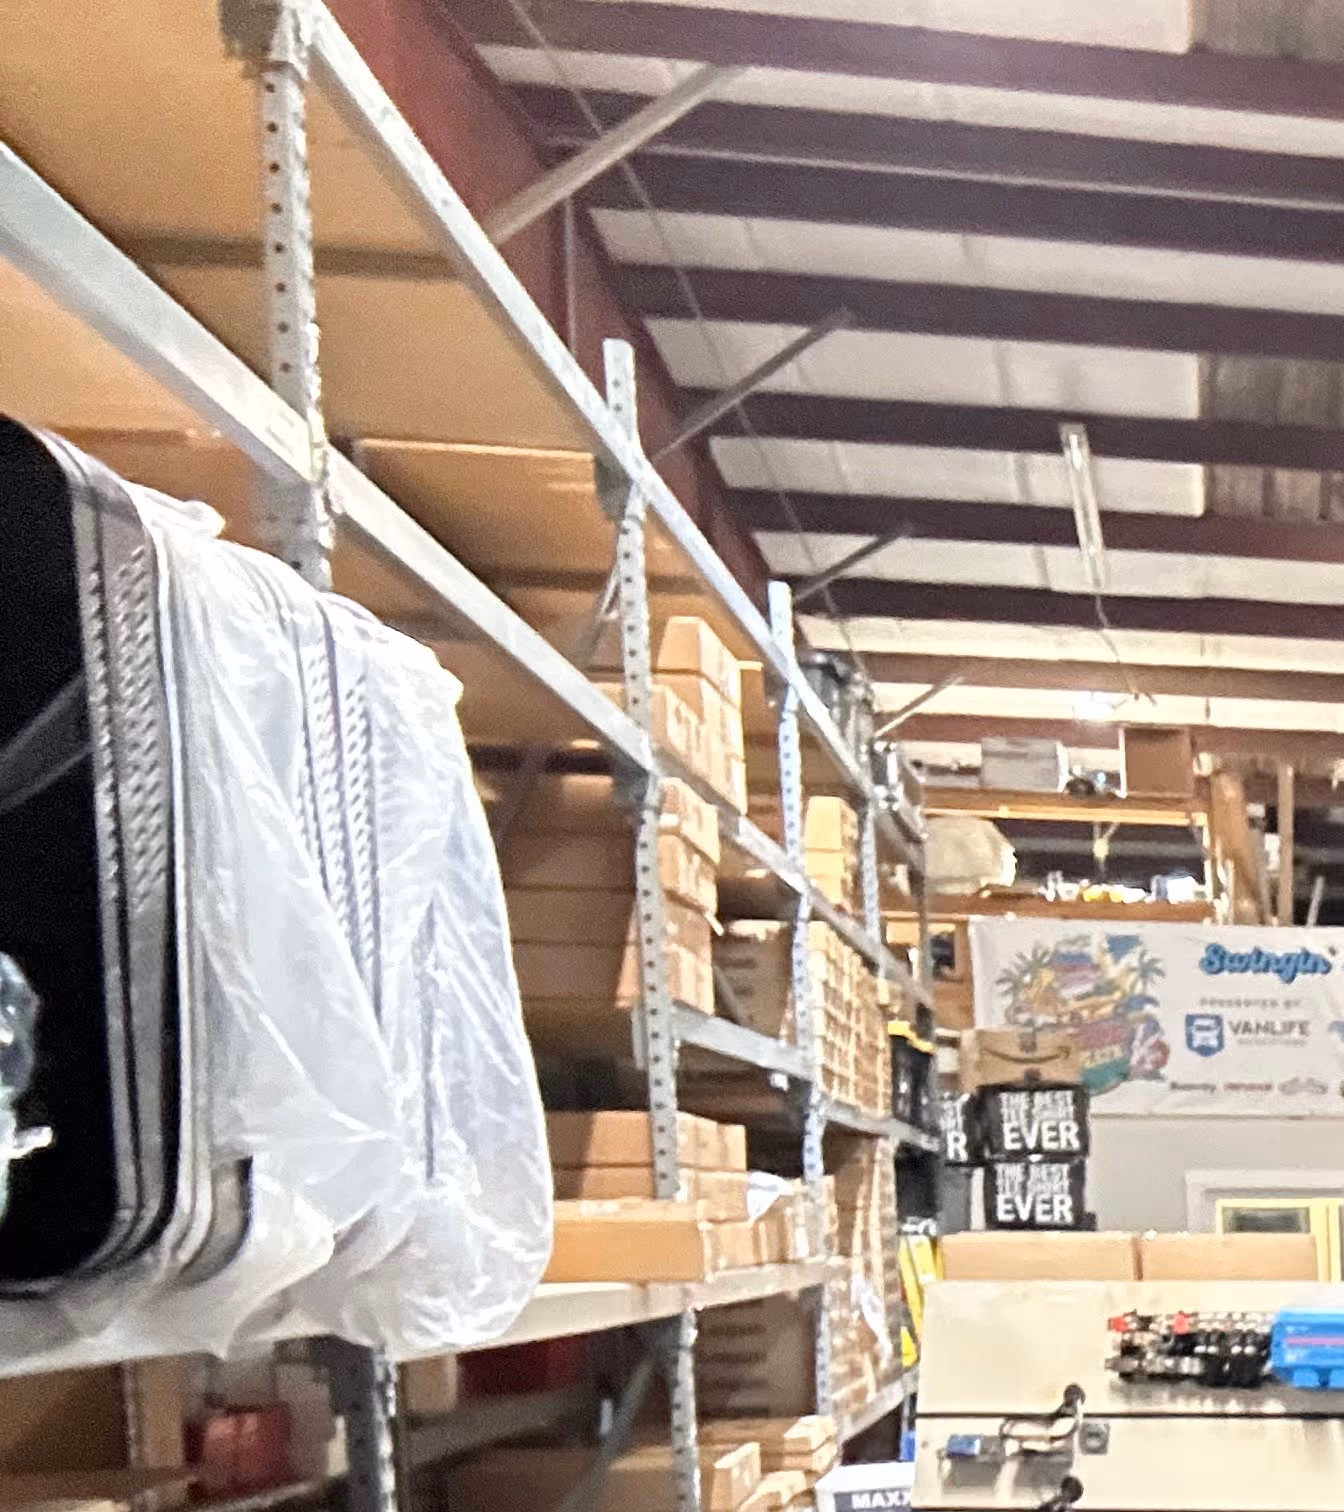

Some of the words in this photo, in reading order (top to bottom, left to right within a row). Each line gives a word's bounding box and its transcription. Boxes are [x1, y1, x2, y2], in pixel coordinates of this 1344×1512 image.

[1227, 1020, 1311, 1037] VANLIFE
[1001, 1119, 1081, 1151] EVER
[996, 1193, 1073, 1224] EVER
